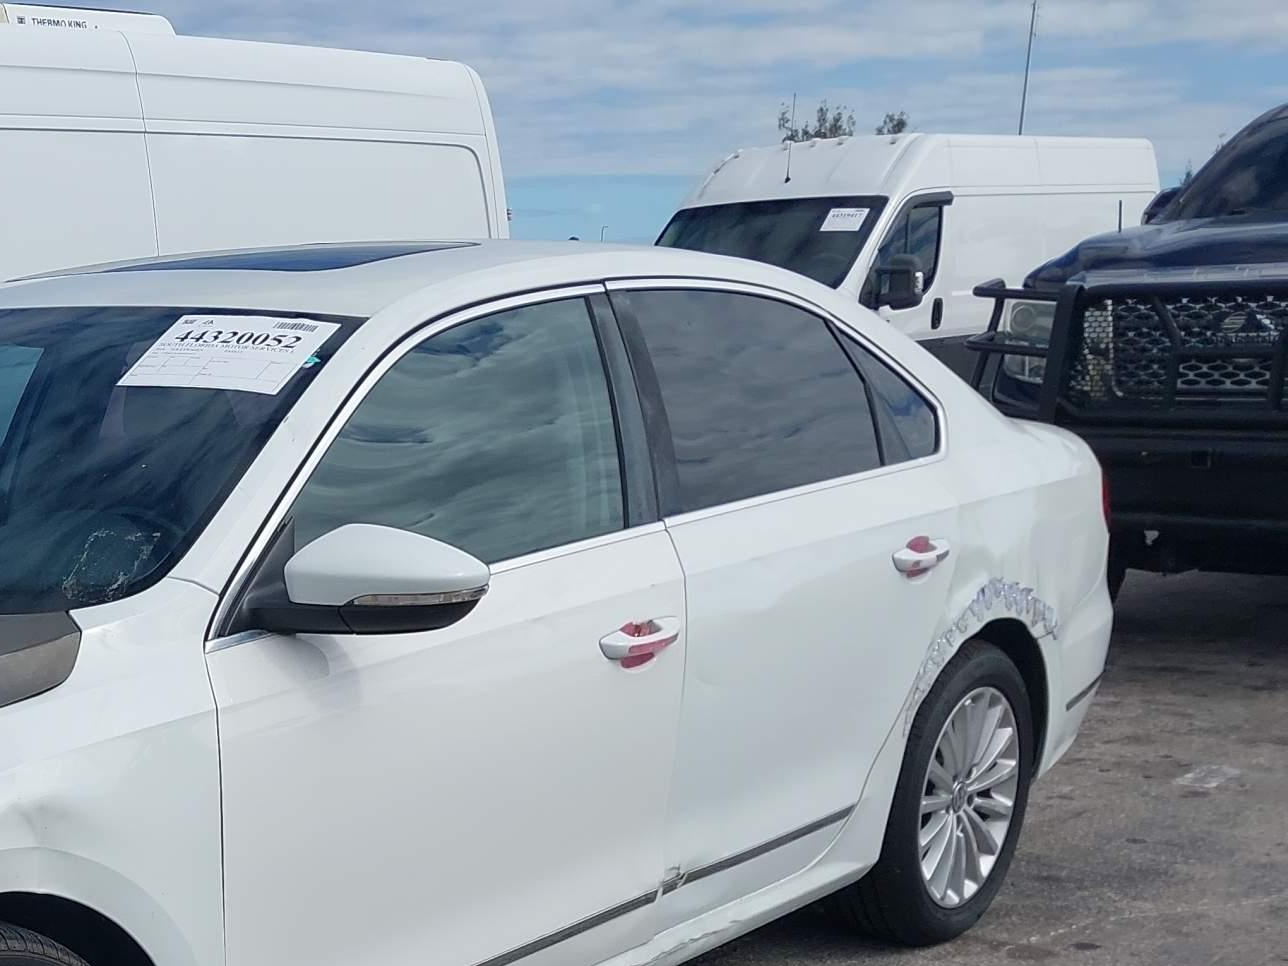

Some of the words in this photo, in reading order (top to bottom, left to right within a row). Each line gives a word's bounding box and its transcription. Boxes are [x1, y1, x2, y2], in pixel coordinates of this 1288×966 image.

[32, 17, 66, 27] THERMO
[68, 19, 88, 29] KING
[175, 329, 303, 349] 44320052
